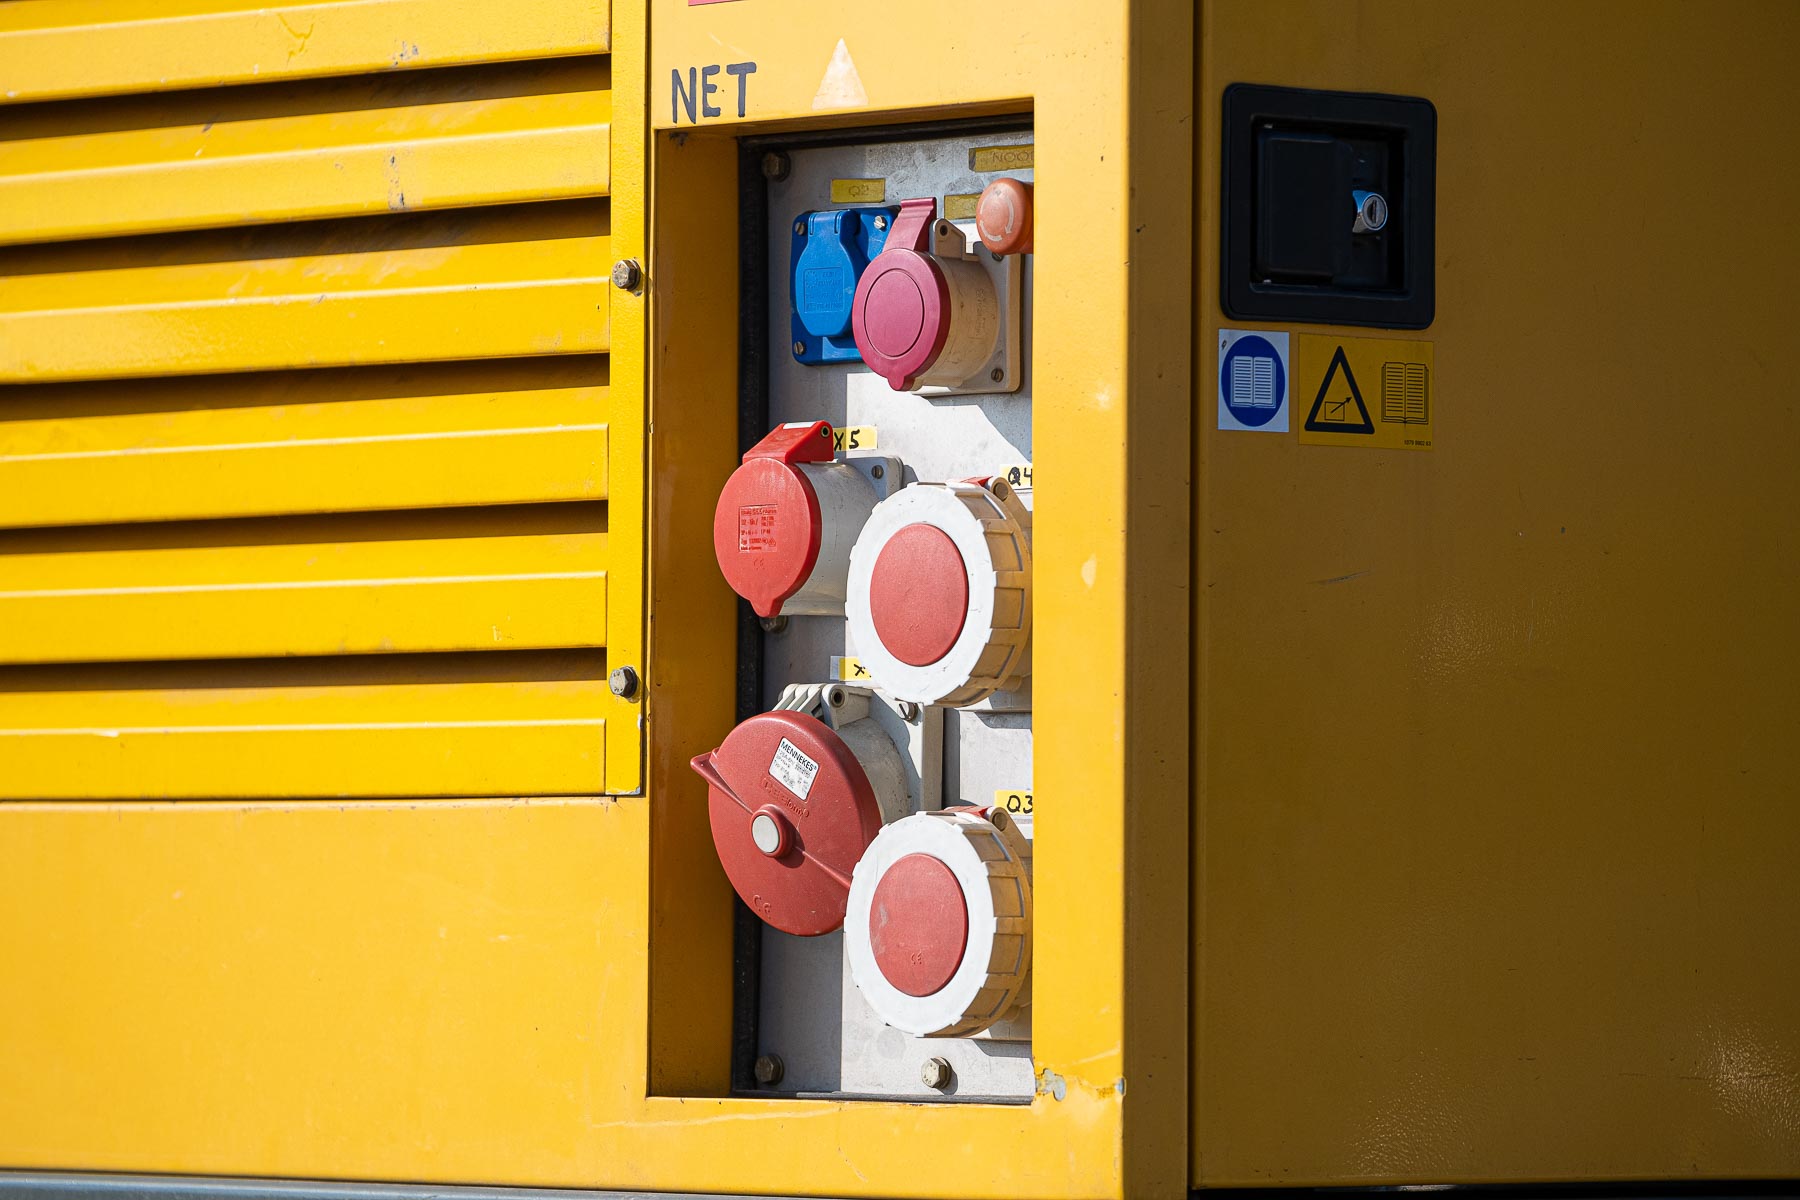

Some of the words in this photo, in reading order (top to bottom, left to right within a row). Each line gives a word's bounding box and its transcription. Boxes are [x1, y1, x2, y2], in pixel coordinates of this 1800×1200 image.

[672, 61, 757, 124] NET
[834, 429, 860, 451] X5
[1007, 466, 1033, 486] Q4
[1006, 794, 1033, 814] Q3
